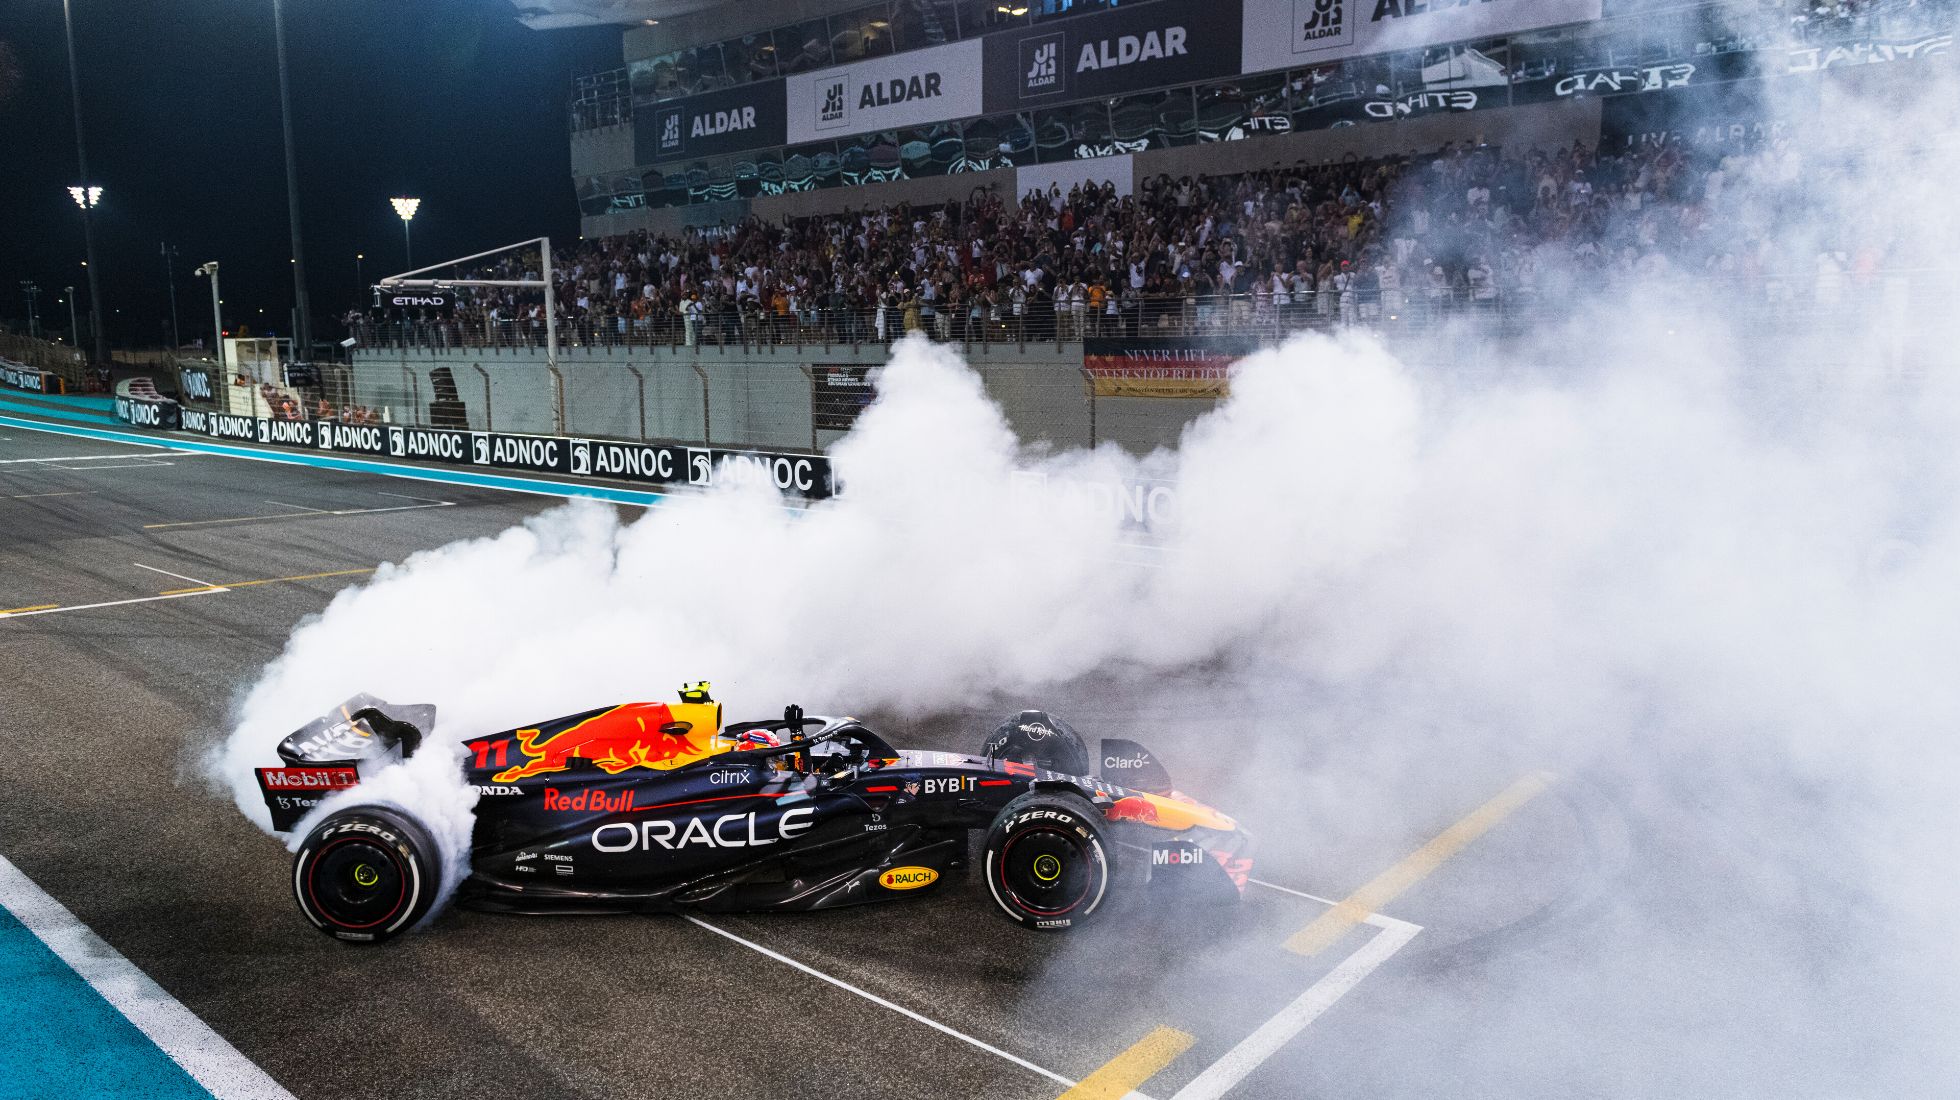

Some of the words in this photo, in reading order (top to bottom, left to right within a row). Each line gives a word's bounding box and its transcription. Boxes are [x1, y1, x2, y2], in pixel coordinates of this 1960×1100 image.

[1304, 27, 1341, 41] ALDAR
[1076, 26, 1187, 72] ALDAR
[858, 72, 942, 109] ALDAR
[1028, 76, 1055, 87] ALDAR
[691, 106, 756, 138] ALDAR
[822, 111, 843, 121] ALDAR
[392, 296, 444, 306] ETIHAD
[1124, 350, 1170, 361] NEVER
[1133, 368, 1168, 380] STOP
[218, 416, 252, 439] ADNOC
[271, 421, 312, 445] ADNOC
[333, 425, 382, 451] ADNOC
[408, 432, 463, 459] ADNOC
[493, 438, 559, 468] ADNOC
[595, 446, 673, 479] ADNOC
[468, 739, 510, 769] 11
[1104, 755, 1145, 769] Claro
[265, 771, 331, 786] Mobil
[710, 769, 750, 784] citrix
[924, 775, 978, 794] BYBIT
[543, 788, 589, 811] Red
[589, 790, 635, 812] Bull
[1019, 811, 1073, 823] ZERO
[337, 823, 397, 841] ZERO
[591, 806, 815, 853] ORACLE
[544, 854, 573, 862] SIEMENS
[1152, 848, 1203, 865] Mobil
[895, 872, 931, 884] RAUCH
